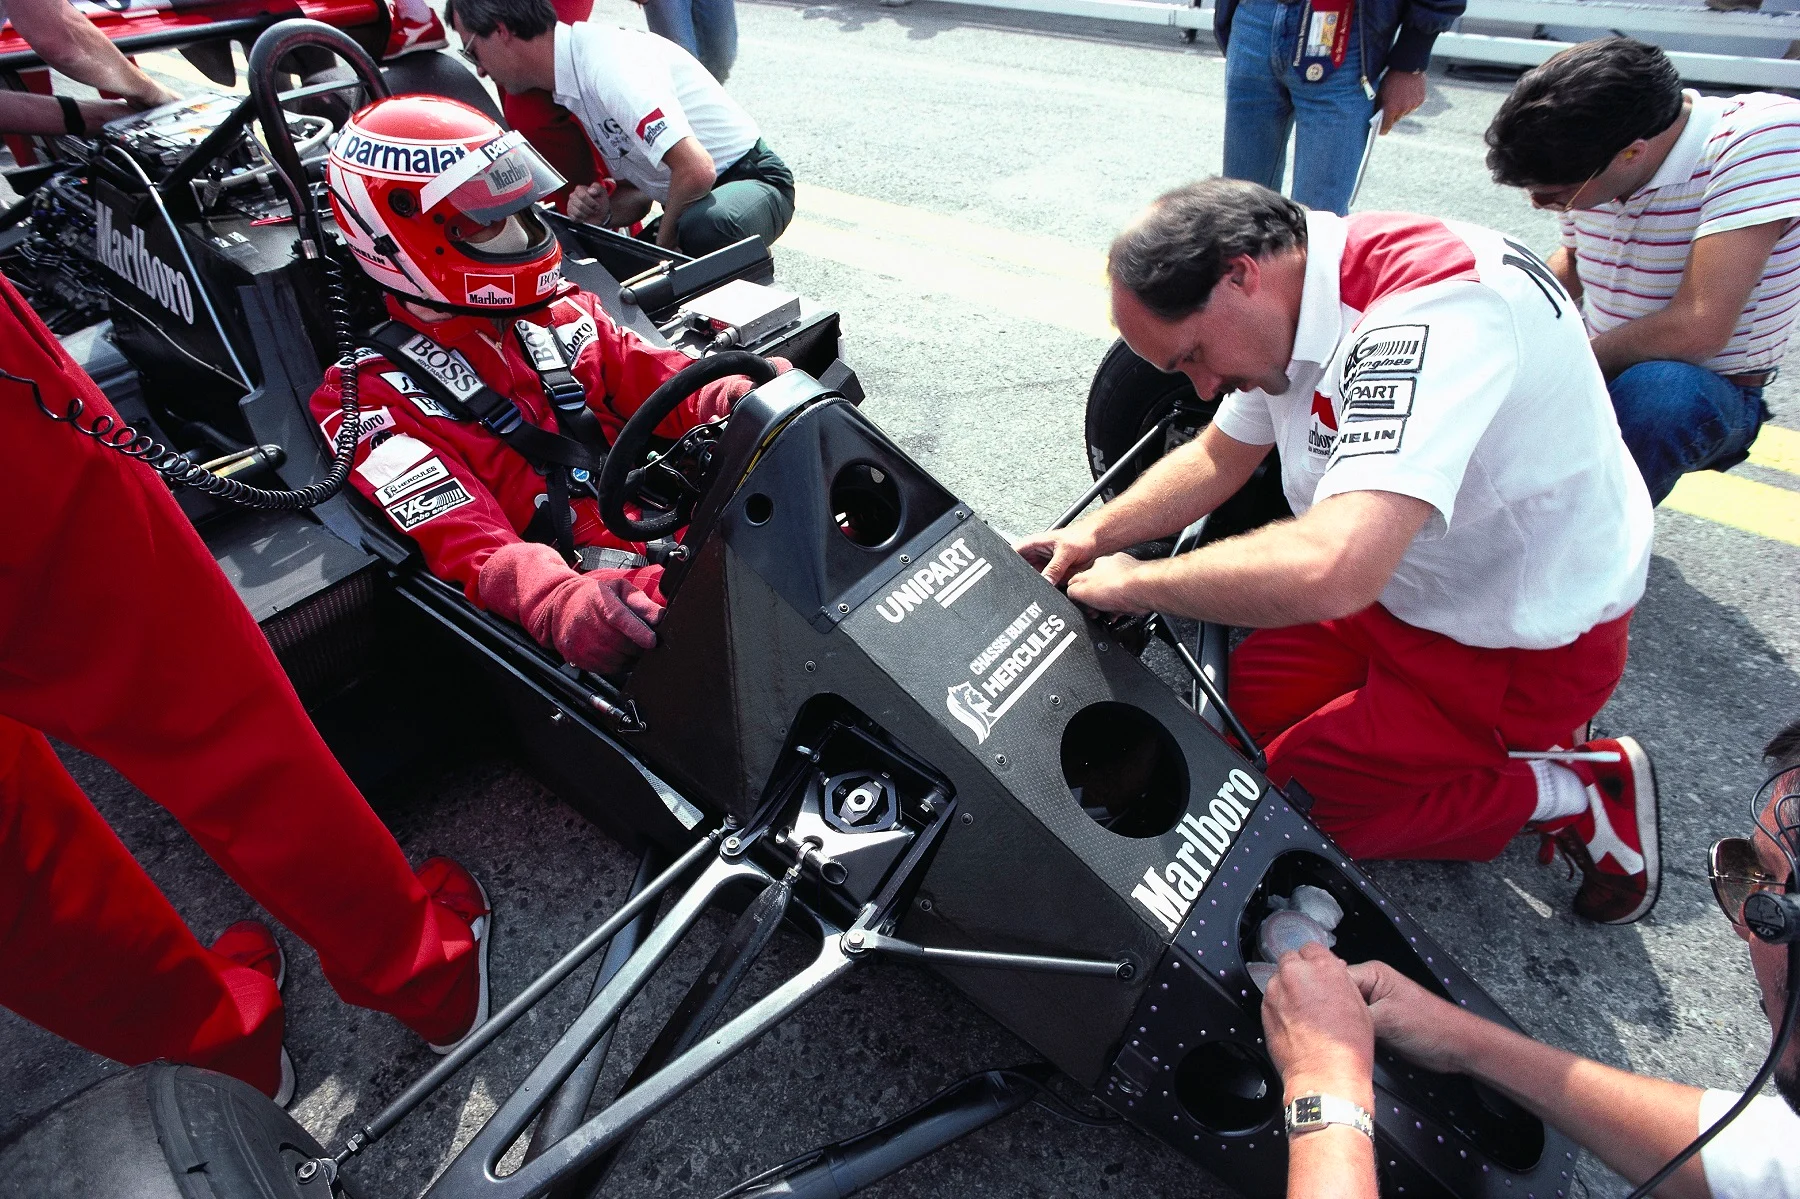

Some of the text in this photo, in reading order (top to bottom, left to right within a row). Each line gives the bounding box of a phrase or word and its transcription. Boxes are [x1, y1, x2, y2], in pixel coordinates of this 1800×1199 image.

[343, 135, 465, 174] parmalat
[96, 200, 194, 325] Marlboro
[469, 291, 513, 305] Marlboro
[409, 336, 478, 393] BOSS
[1351, 385, 1399, 400] PART
[397, 466, 438, 489] HERCULES
[393, 495, 438, 520] TAG
[876, 538, 976, 624] UNIPART
[969, 601, 1043, 676] CHASSIS BUILT BY
[981, 614, 1066, 699] HERCULES
[1130, 768, 1261, 934] Marlboro
